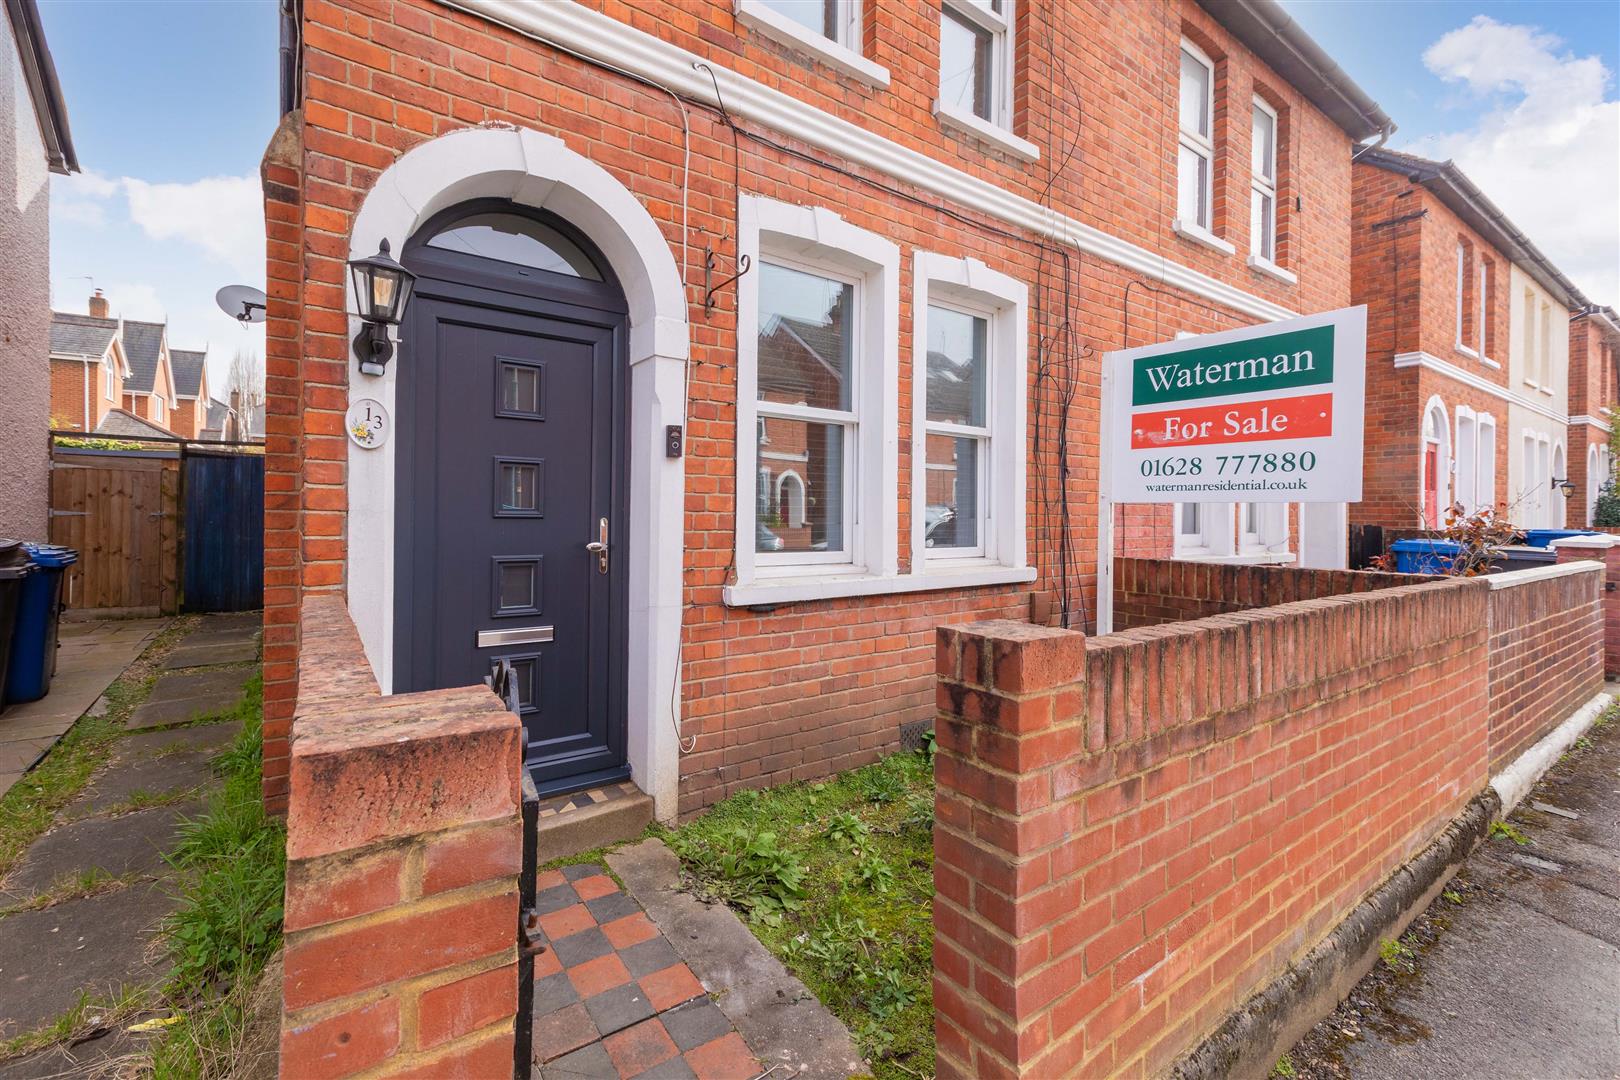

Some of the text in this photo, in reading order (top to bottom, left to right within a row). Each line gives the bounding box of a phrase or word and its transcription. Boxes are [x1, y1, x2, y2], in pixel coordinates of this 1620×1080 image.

[1146, 349, 1316, 392] Waterman
[365, 407, 383, 429] 13
[1162, 407, 1289, 441] For Sale
[1140, 451, 1316, 477] 01628 777880
[1145, 478, 1308, 492] watermanresidential.co.uk
